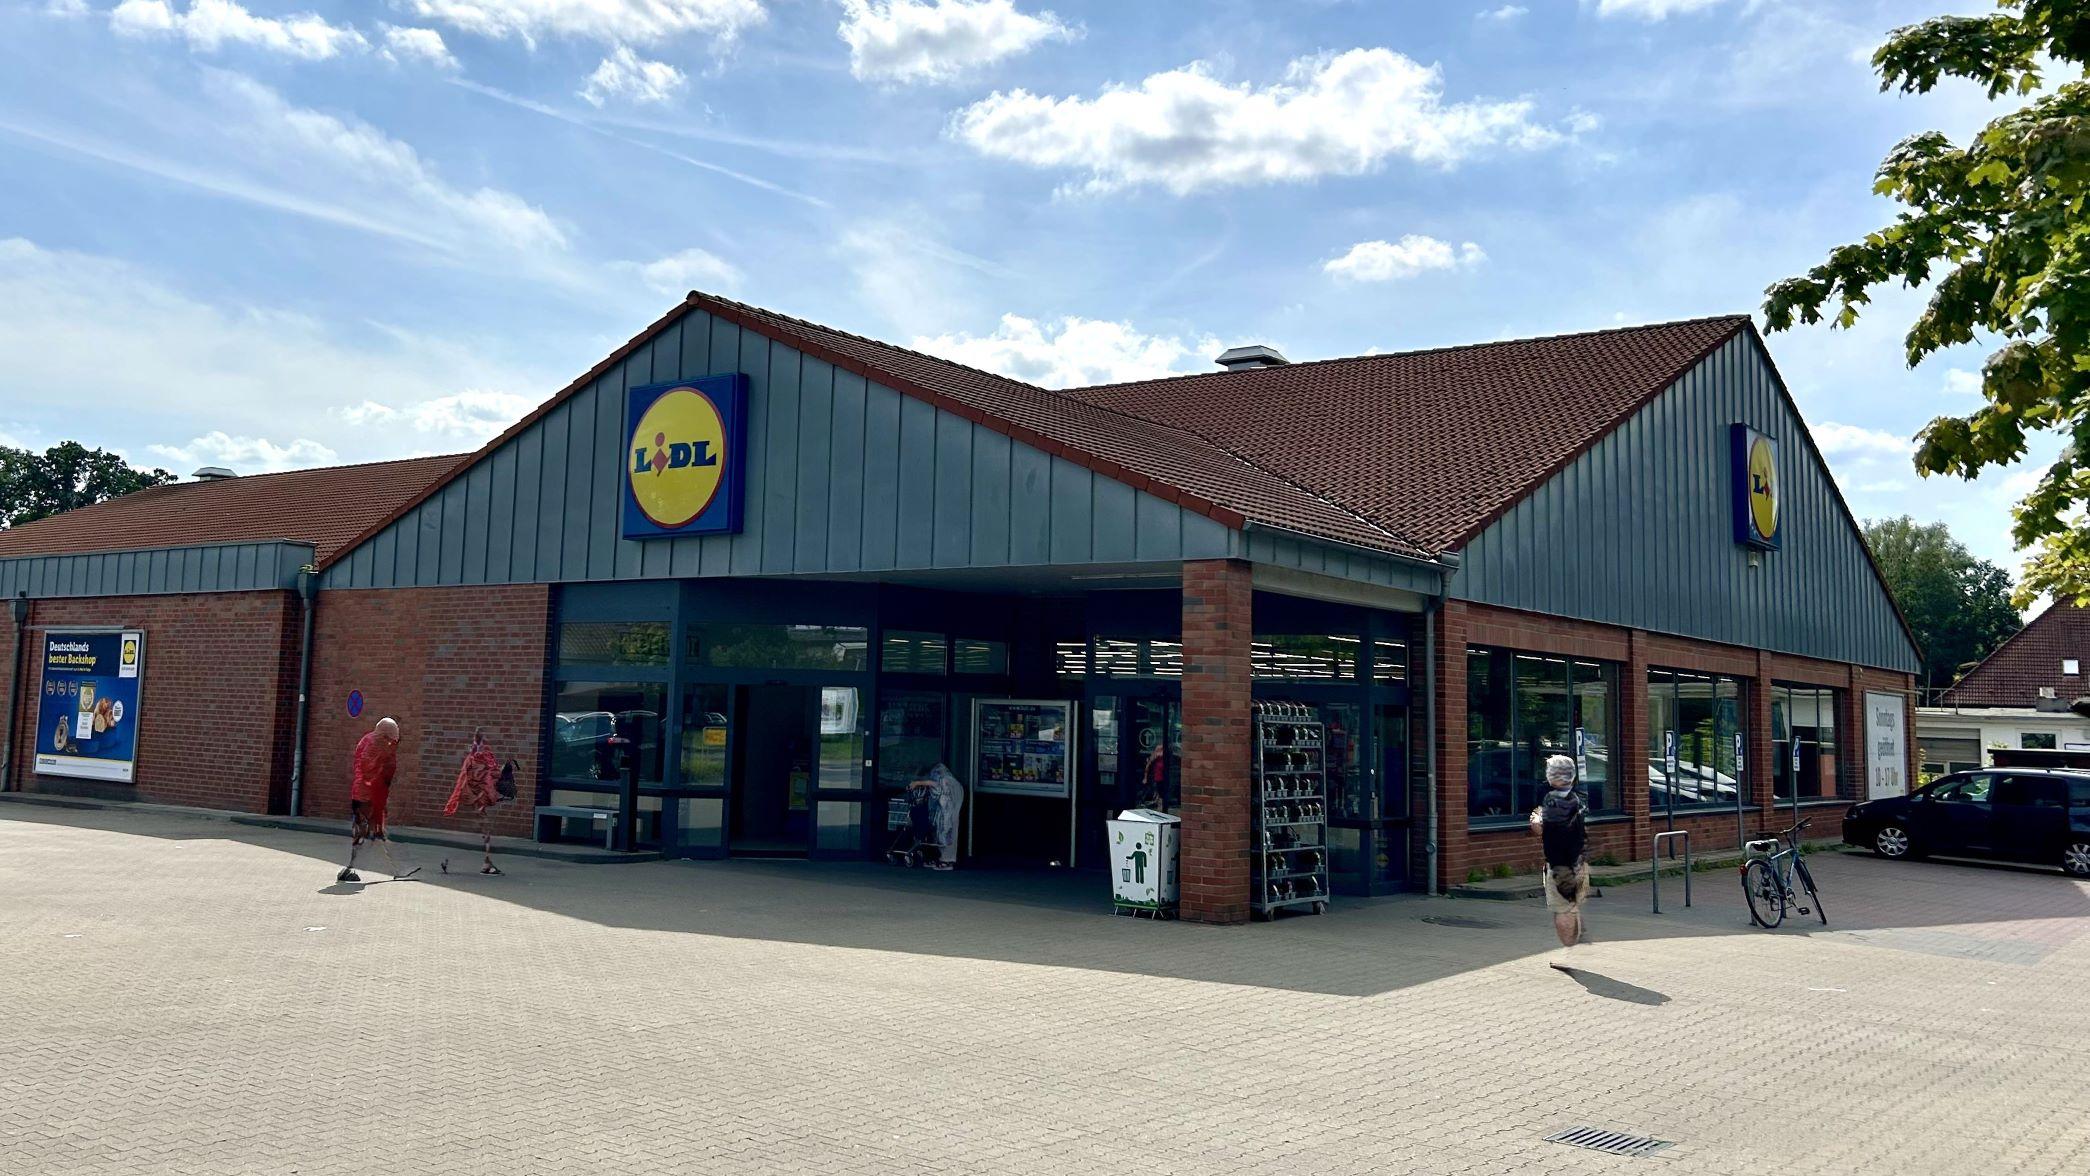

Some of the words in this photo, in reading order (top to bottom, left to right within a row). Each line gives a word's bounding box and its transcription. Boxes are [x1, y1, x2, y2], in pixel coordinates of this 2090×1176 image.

[634, 432, 717, 477] LIDL
[49, 641, 89, 652] Deutschlands
[48, 653, 68, 664] bester
[68, 653, 96, 666] Backshop
[1876, 706, 1895, 732] Sonntags
[1576, 730, 1583, 755] P
[1666, 732, 1672, 755] P
[1736, 735, 1741, 754] P
[1794, 738, 1799, 755] P
